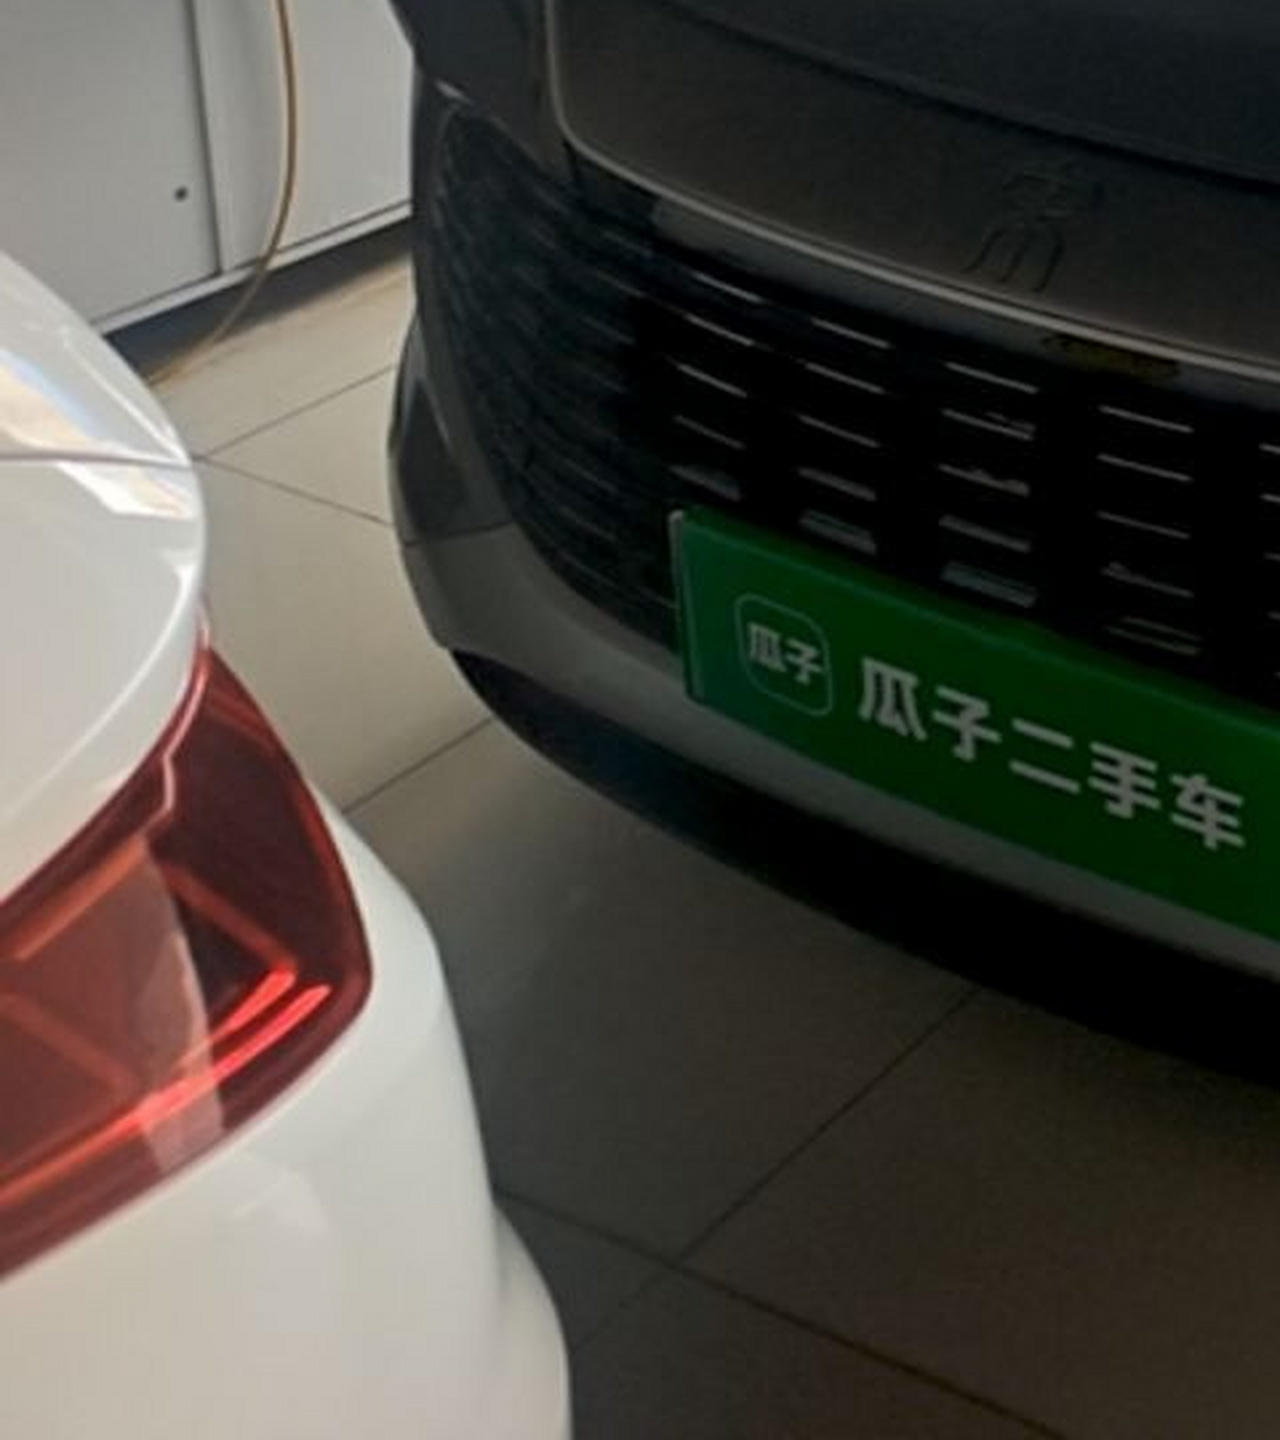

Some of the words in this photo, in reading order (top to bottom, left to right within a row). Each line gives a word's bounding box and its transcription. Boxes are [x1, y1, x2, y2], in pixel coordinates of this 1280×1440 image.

[747, 622, 825, 685] 瓜子
[857, 656, 1246, 851] 瓜子二手车
